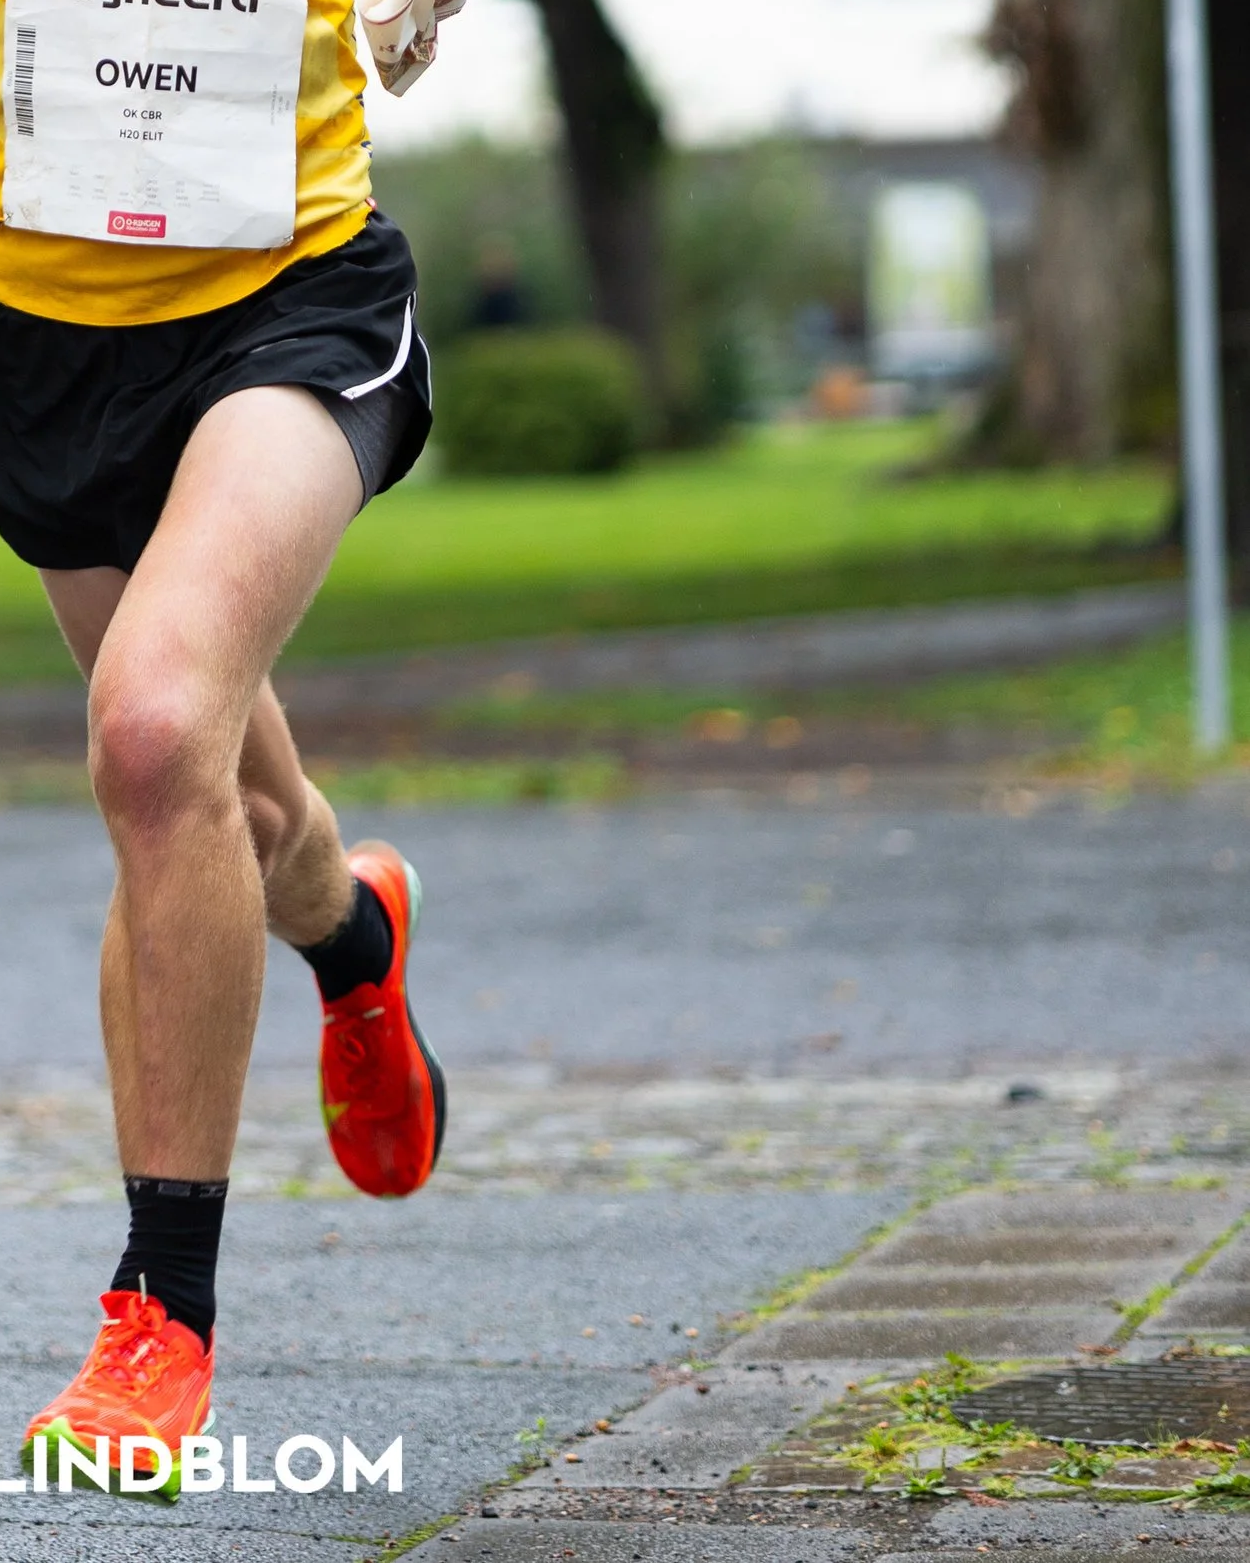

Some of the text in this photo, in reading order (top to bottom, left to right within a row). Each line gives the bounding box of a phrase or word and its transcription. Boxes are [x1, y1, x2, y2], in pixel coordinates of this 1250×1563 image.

[95, 58, 198, 93] OWEN
[123, 108, 162, 120] OK CBR
[142, 131, 163, 141] ELIT
